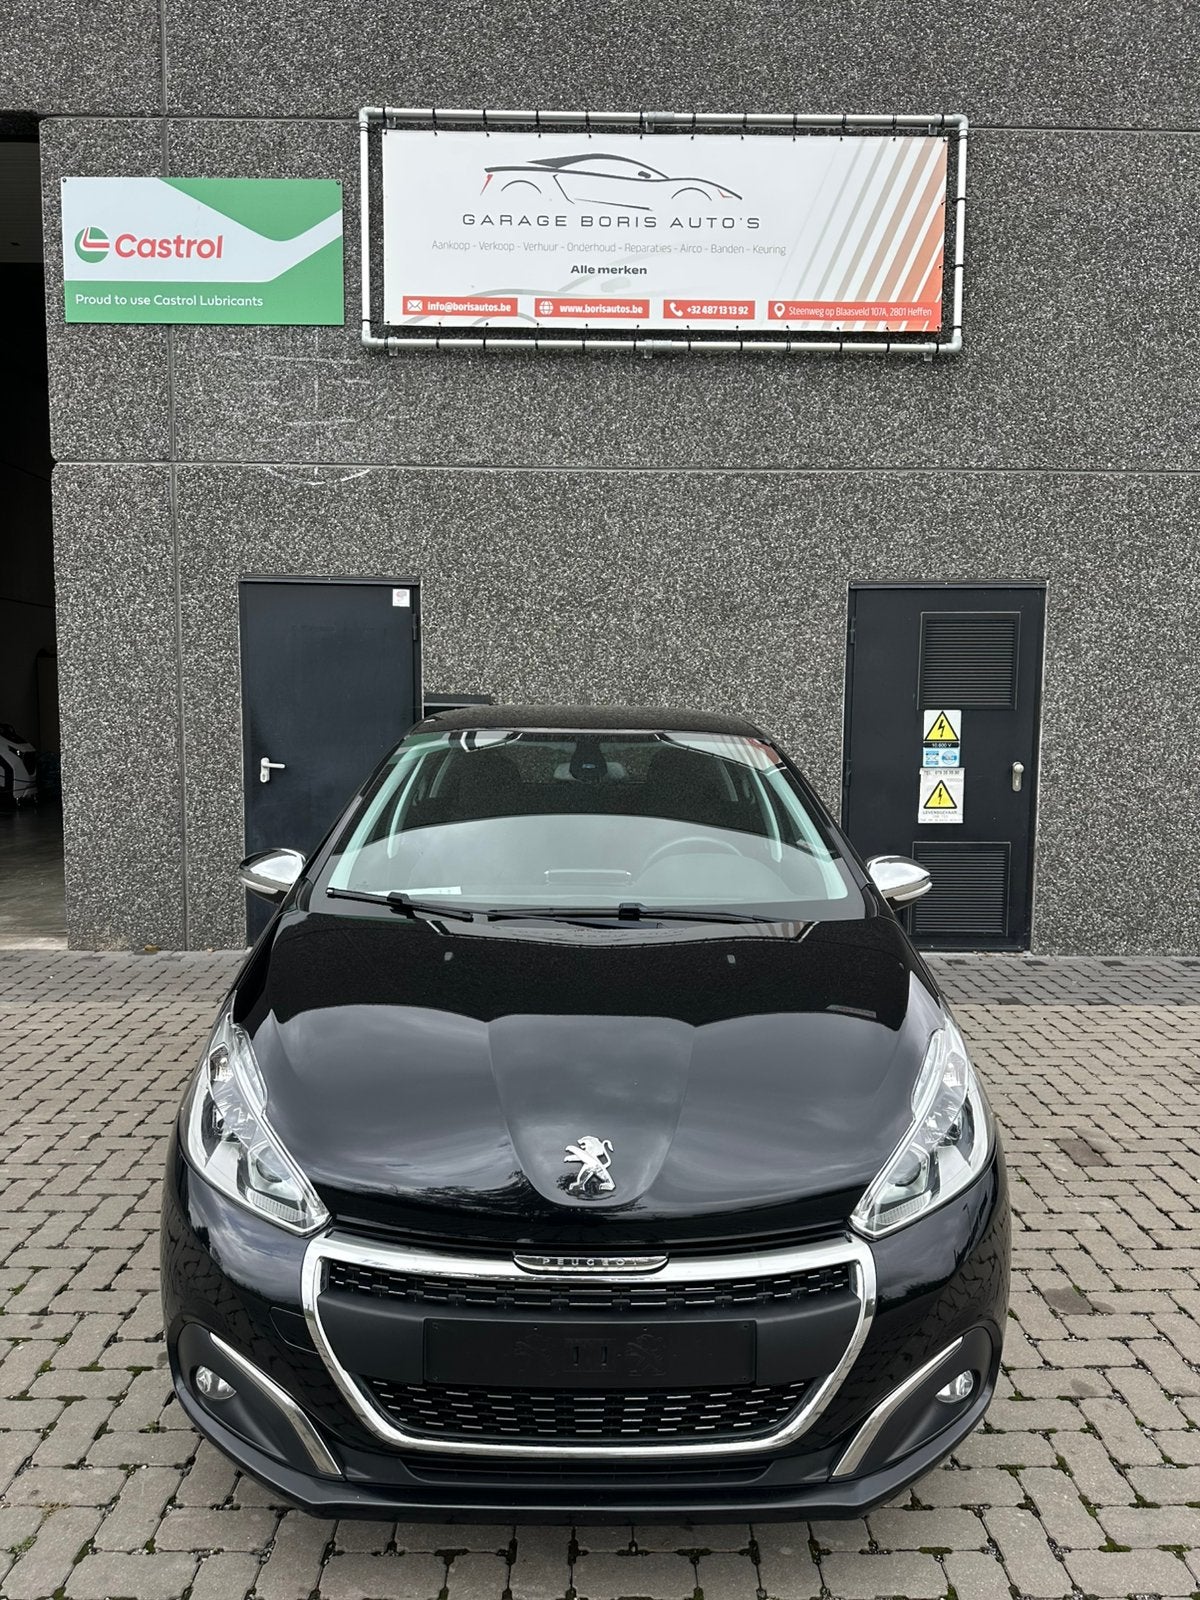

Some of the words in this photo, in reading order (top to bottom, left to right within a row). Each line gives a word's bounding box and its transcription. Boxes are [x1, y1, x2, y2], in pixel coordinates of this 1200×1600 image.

[463, 214, 567, 226] GARAGE
[581, 216, 657, 228] BORIS
[670, 217, 760, 229] AUTO'S
[115, 234, 223, 259] Castrol
[432, 240, 470, 252] Aankoop
[479, 241, 515, 253] Verkoop
[523, 242, 558, 251] Verhuur
[567, 242, 616, 252] Onderhoud
[625, 243, 672, 255] Reparaties
[680, 244, 702, 253] Airco
[711, 244, 744, 254] Banden
[753, 245, 786, 256] Keuring
[571, 265, 595, 274] Alle
[598, 266, 647, 275] merken
[75, 294, 111, 305] Proud
[115, 295, 127, 305] to
[130, 297, 150, 306] use
[154, 295, 197, 306] Castrol
[200, 295, 263, 307] Lubricants
[428, 301, 511, 312] info@borisautos.be
[560, 304, 643, 314] www.borisautos.be
[687, 306, 701, 314] +32
[702, 306, 718, 314] 487
[719, 306, 728, 314] 13
[729, 306, 737, 314] 13
[738, 306, 748, 315] 92
[789, 306, 824, 317] Steenweg
[825, 309, 834, 317] op
[836, 307, 870, 316] Blaasveld
[890, 308, 907, 316] 2801
[908, 308, 932, 316] Heffen
